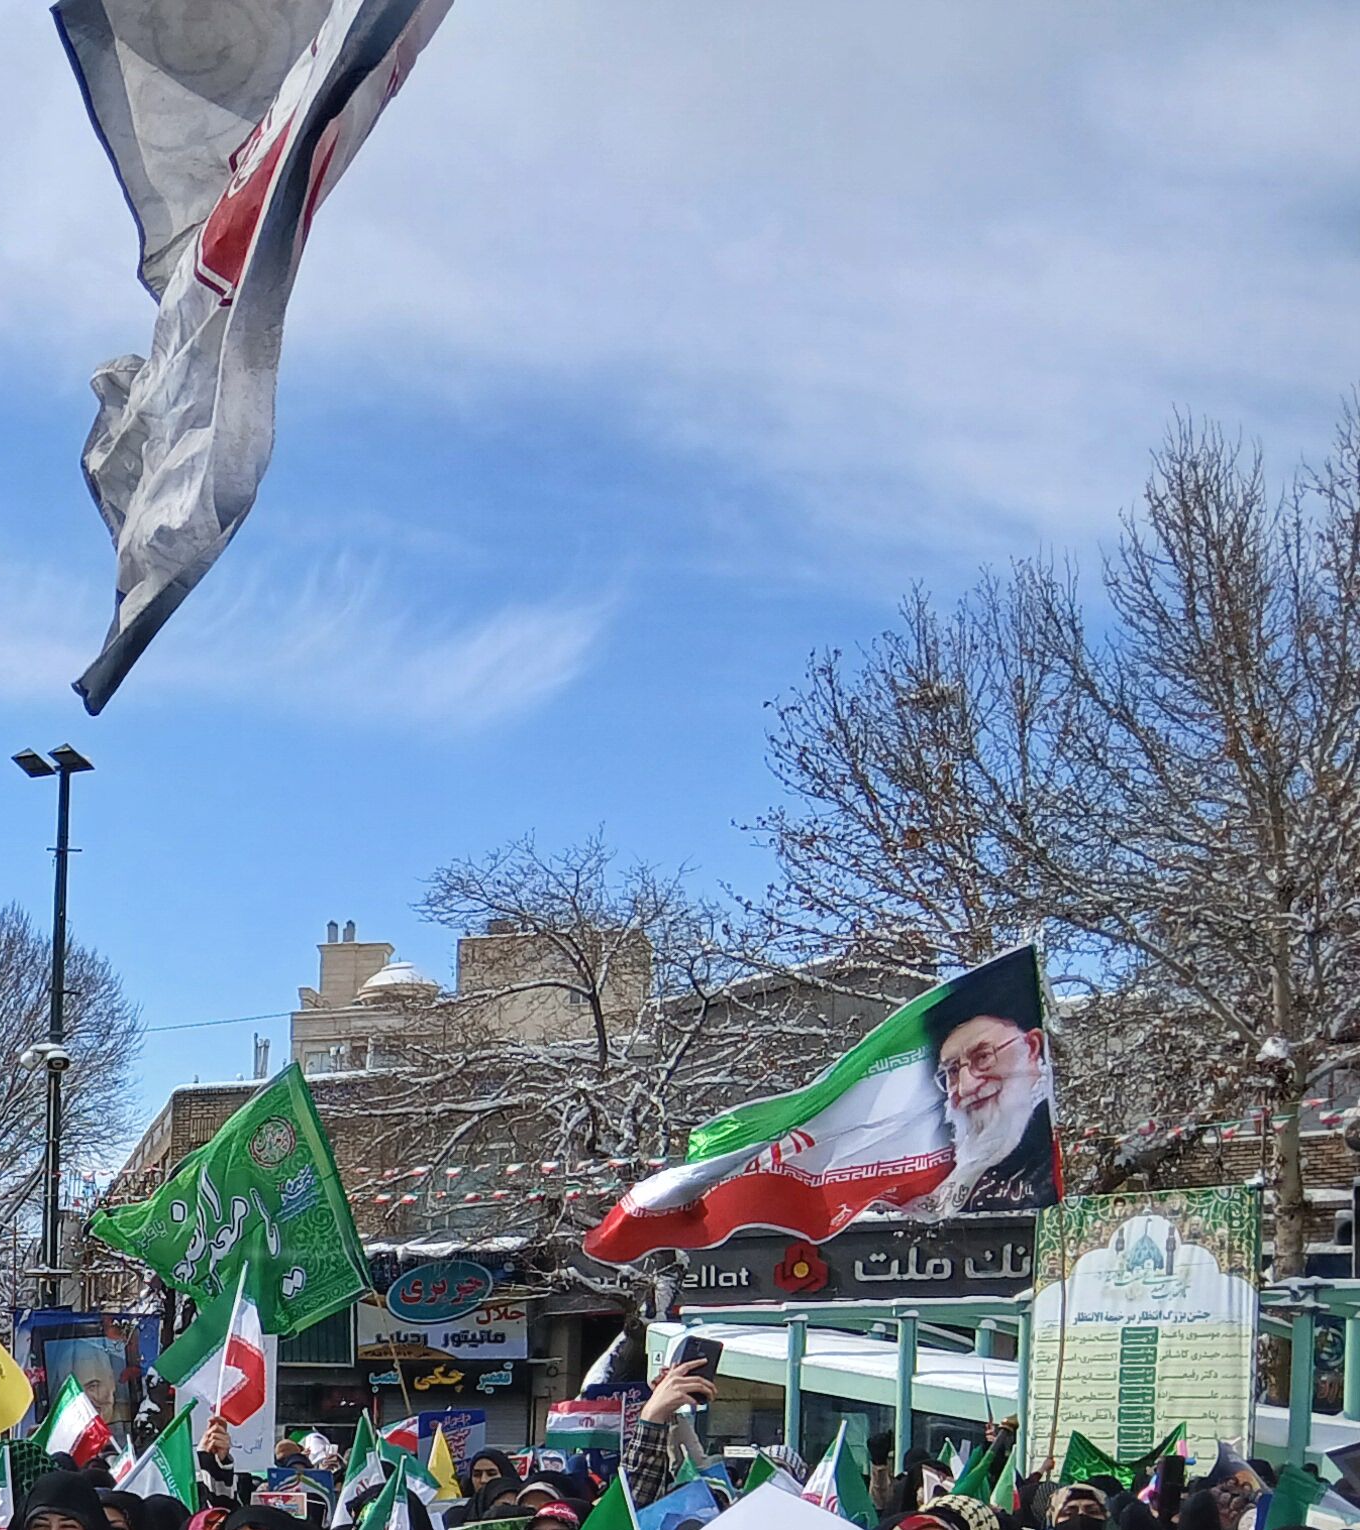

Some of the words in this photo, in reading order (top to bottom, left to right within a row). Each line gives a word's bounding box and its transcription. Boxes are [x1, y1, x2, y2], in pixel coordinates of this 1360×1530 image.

[682, 1264, 749, 1288] ellat
[854, 1246, 952, 1282] ملت
[964, 1243, 1031, 1280] نک
[441, 1329, 506, 1348] مانیتور
